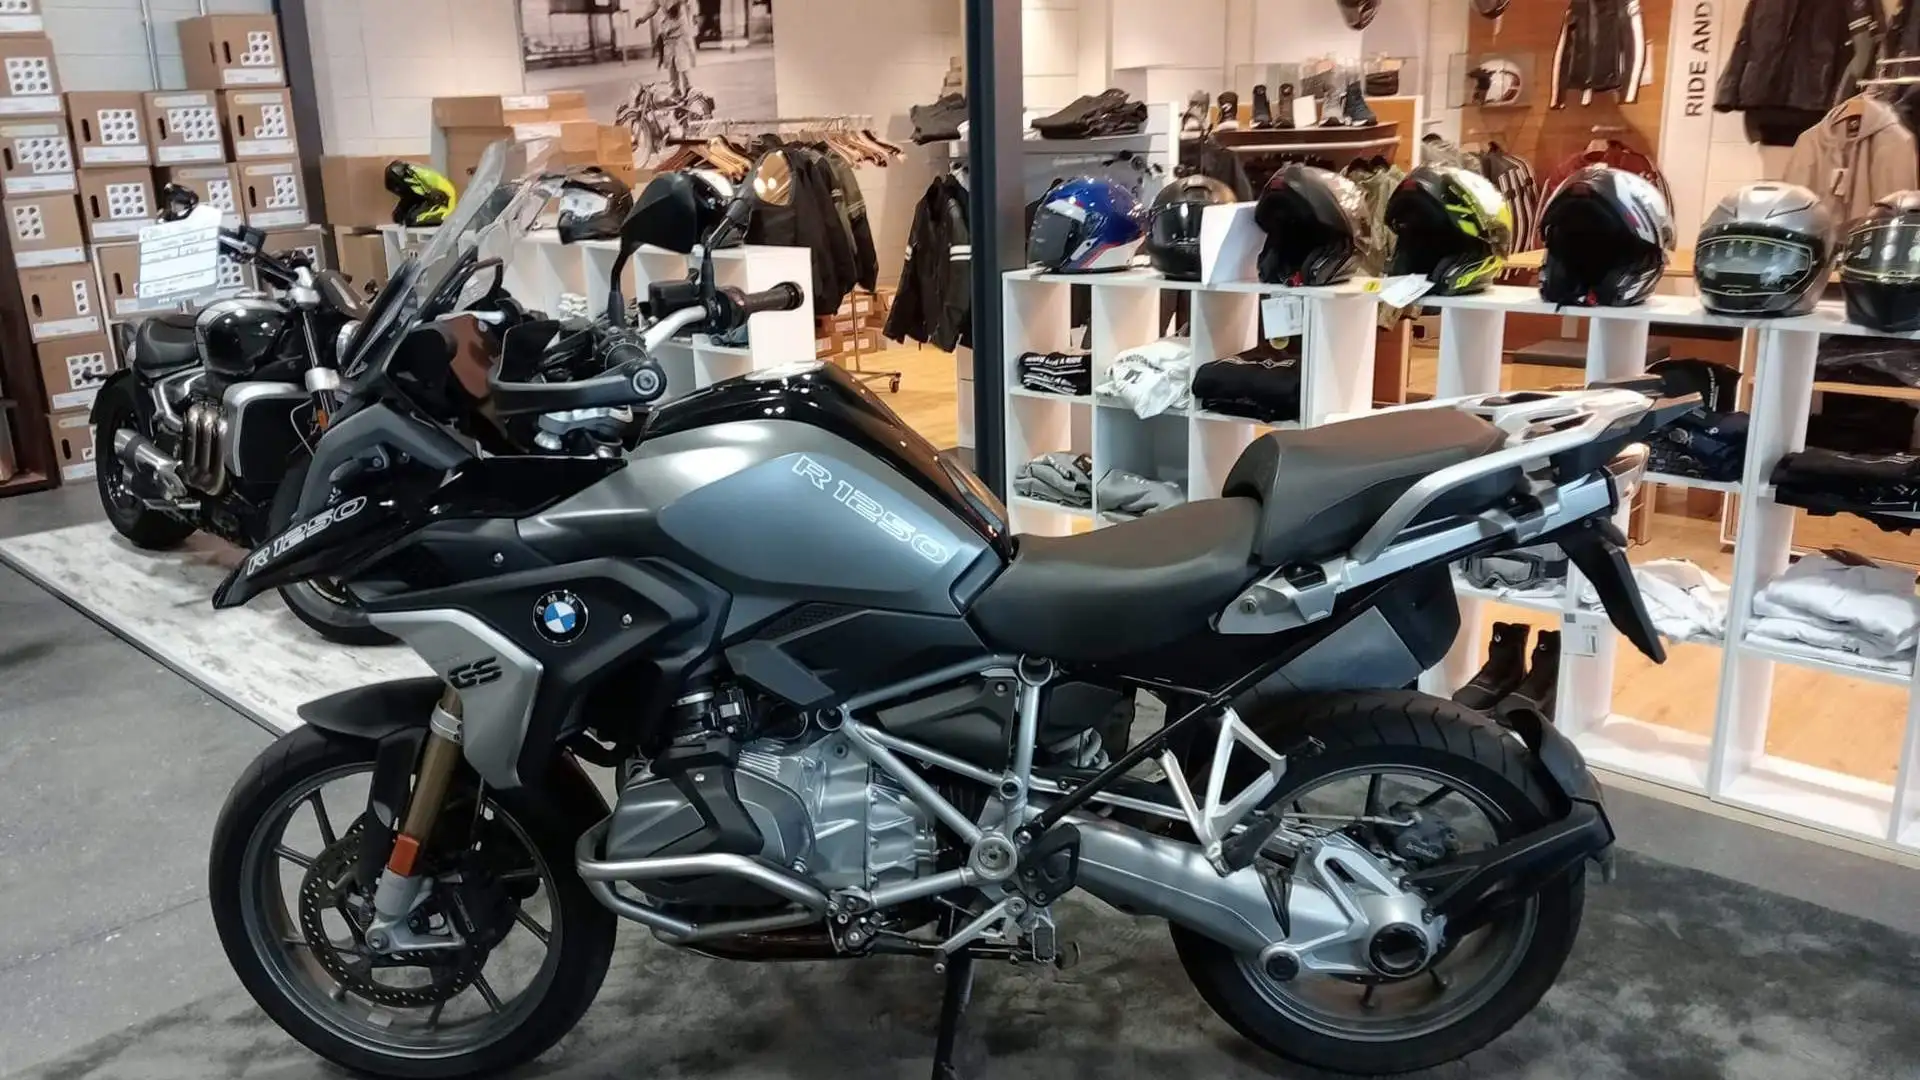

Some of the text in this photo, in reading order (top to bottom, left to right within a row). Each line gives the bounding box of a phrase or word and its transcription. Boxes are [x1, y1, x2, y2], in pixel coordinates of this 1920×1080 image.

[1685, 0, 1712, 117] RIDE AND
[246, 496, 367, 577] R 1250
[791, 454, 949, 564] R 1250
[536, 593, 576, 616] BMW
[448, 656, 503, 689] GS
